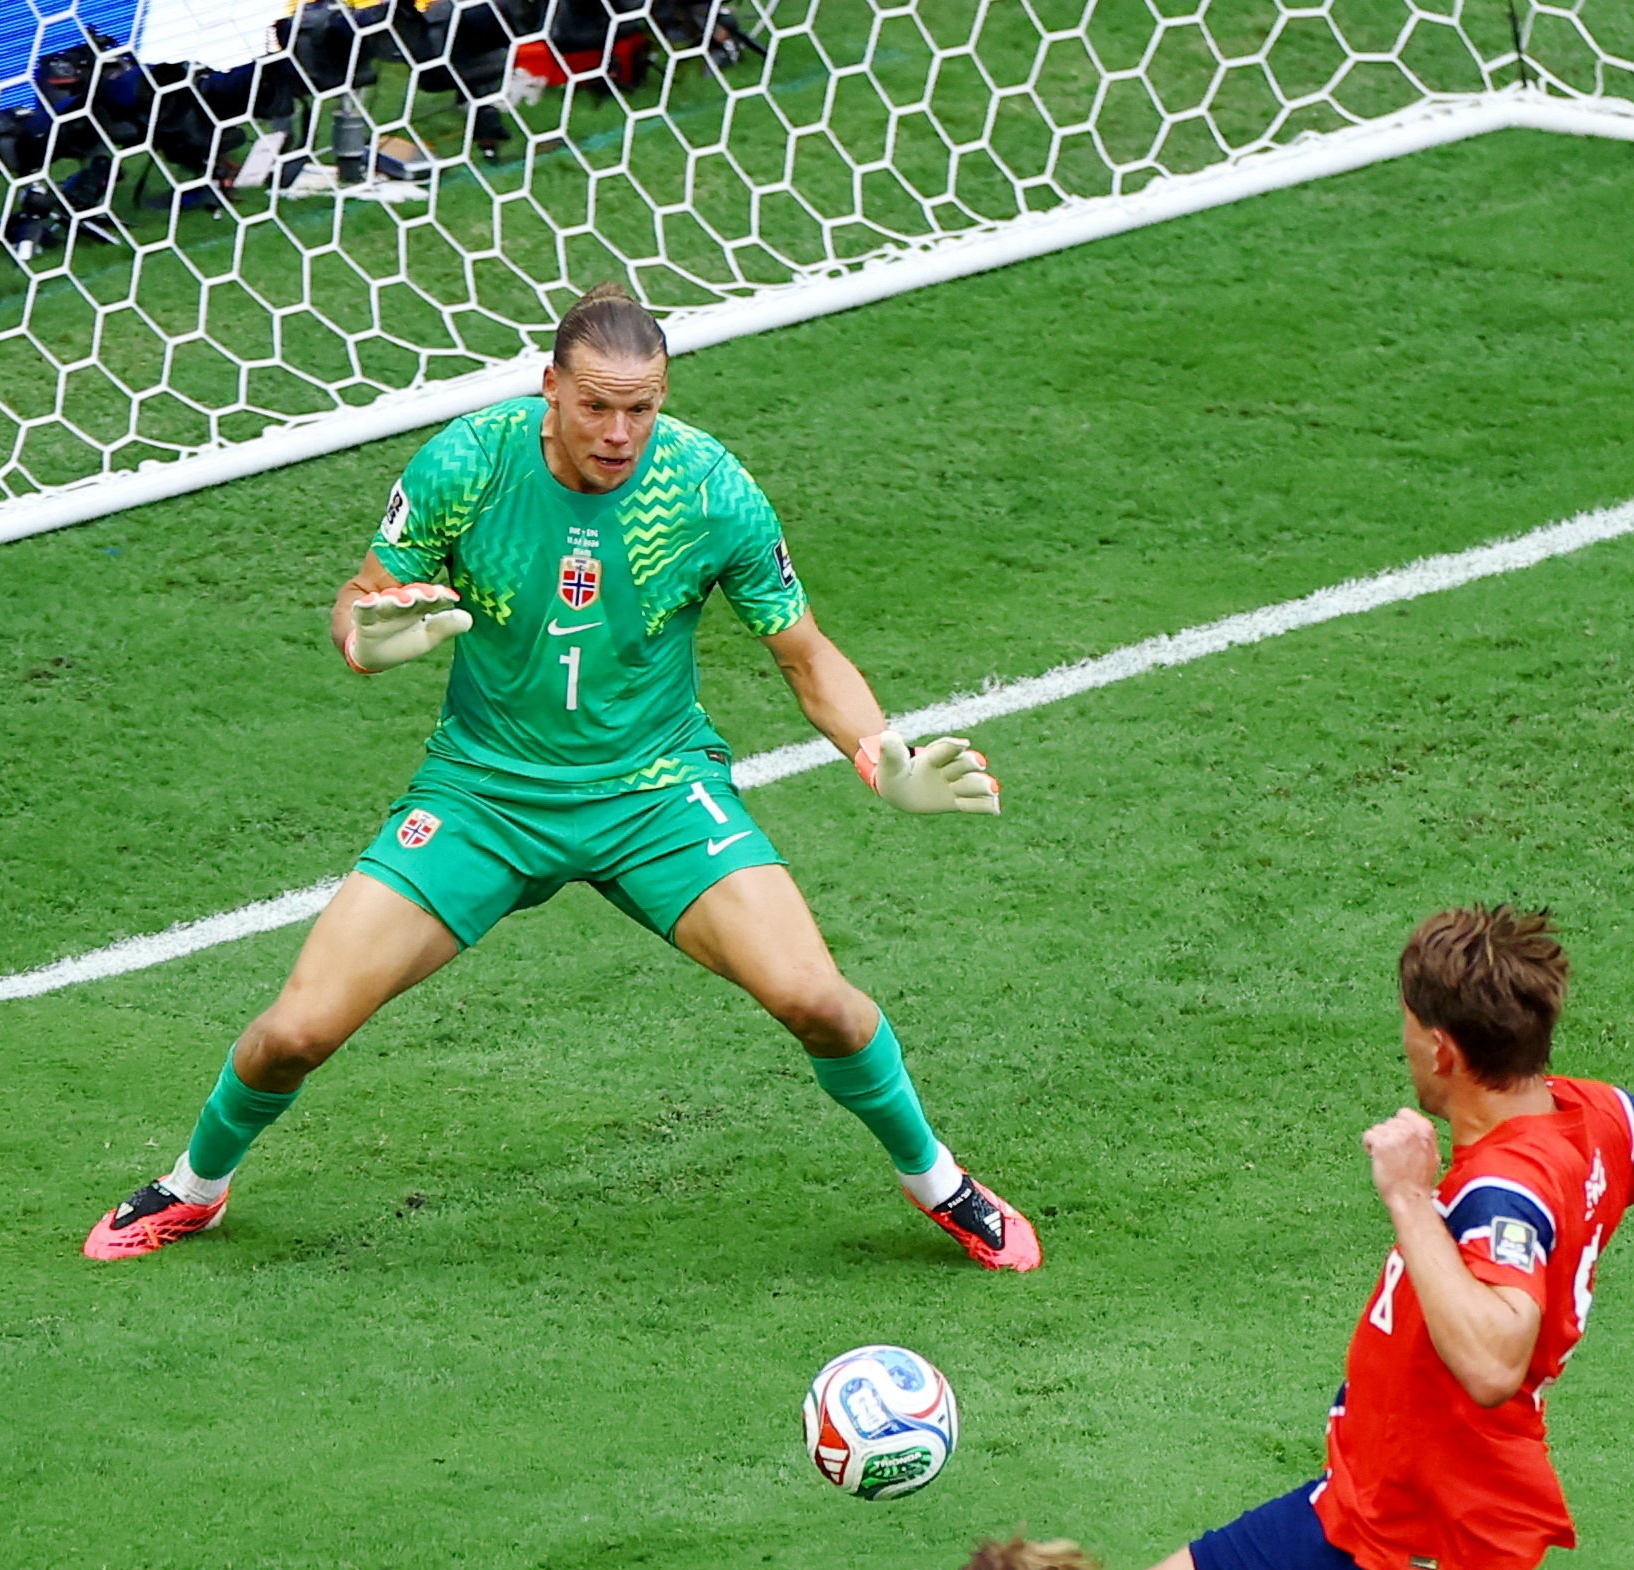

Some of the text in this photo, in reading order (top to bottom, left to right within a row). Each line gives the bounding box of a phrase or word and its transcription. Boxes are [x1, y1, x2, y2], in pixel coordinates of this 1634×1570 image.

[559, 646, 581, 710] 1
[686, 781, 728, 824] 1
[1369, 1249, 1404, 1335] 8
[873, 1451, 922, 1468] TRIONDA
